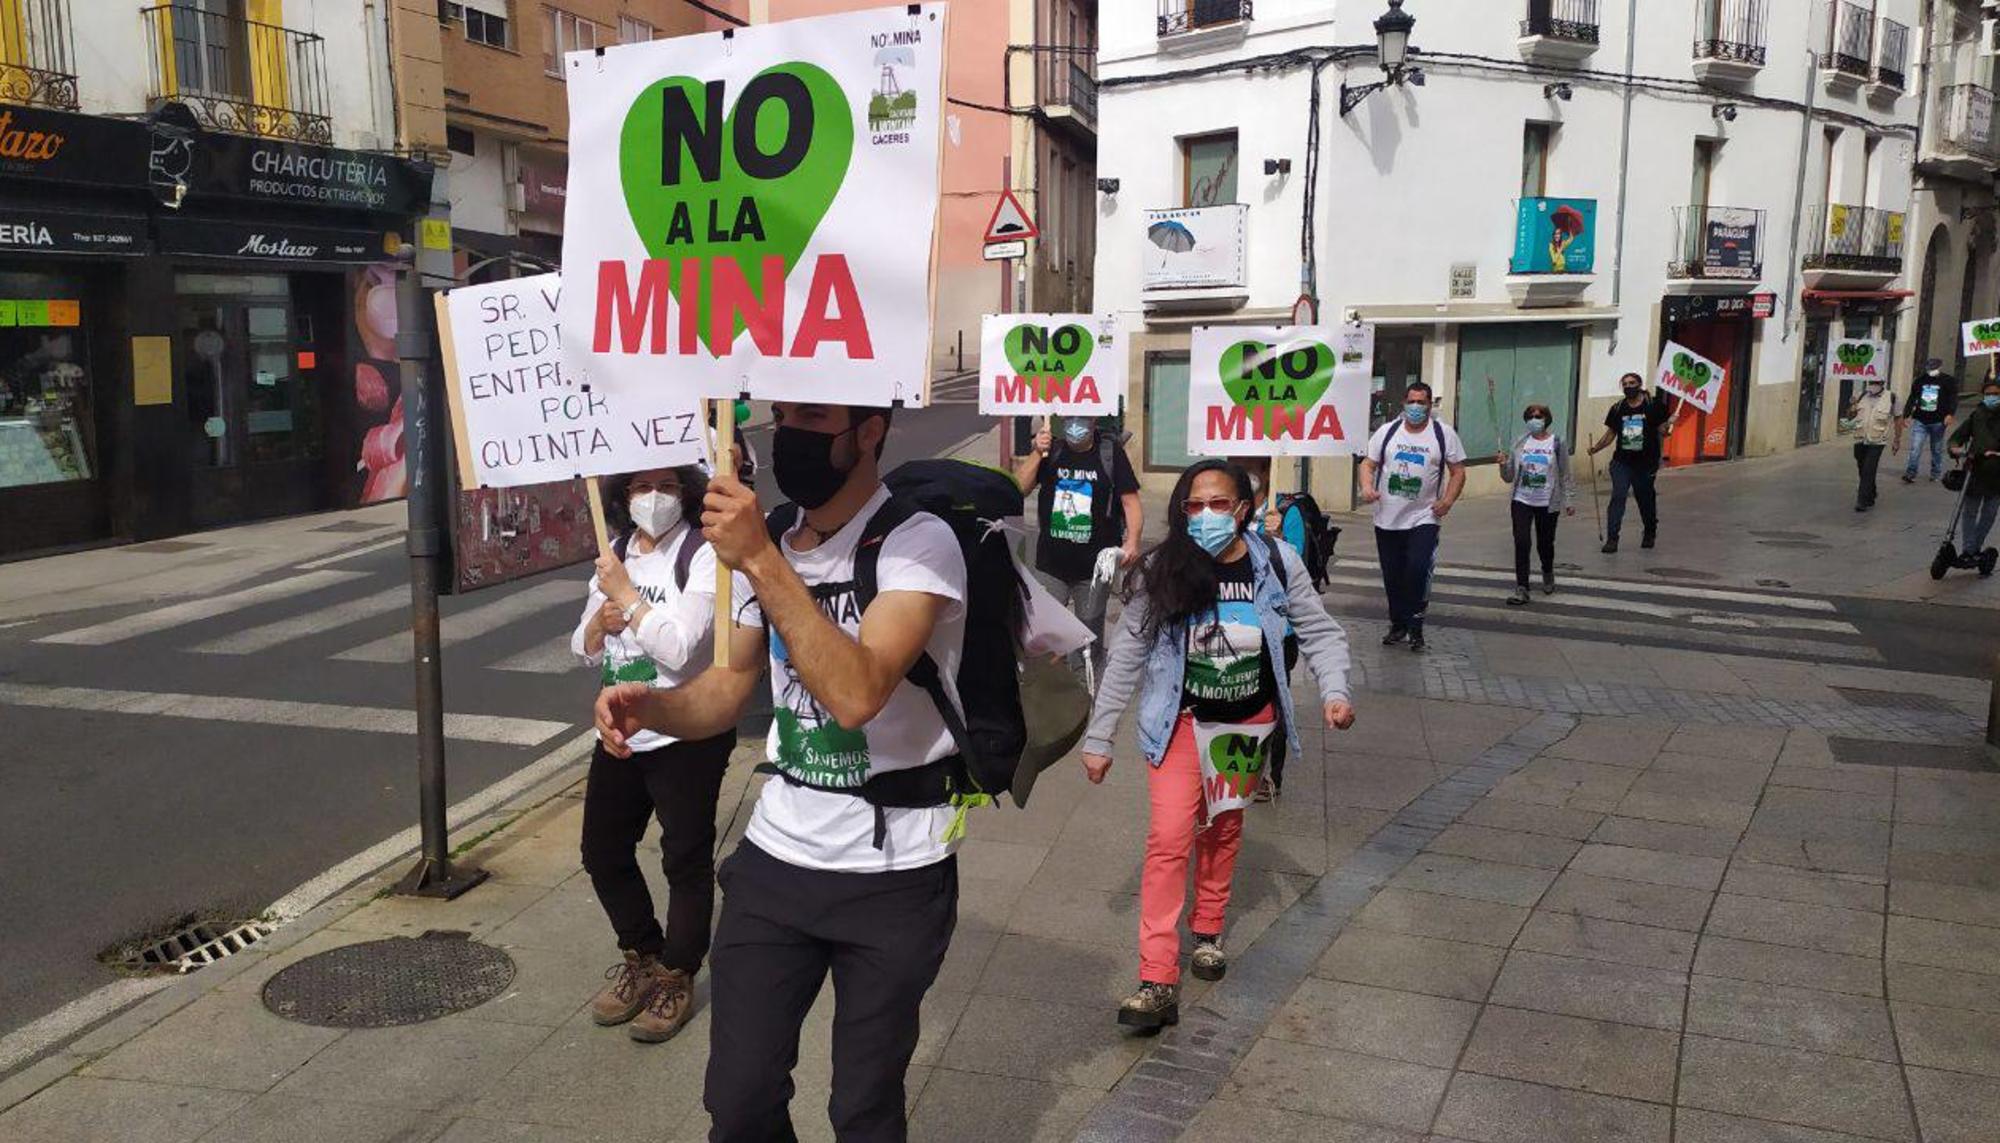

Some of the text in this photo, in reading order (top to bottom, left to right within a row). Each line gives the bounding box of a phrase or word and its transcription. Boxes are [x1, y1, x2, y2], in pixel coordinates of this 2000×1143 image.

[871, 30, 921, 48] NO MINA
[661, 71, 815, 186] NO
[251, 151, 387, 186] CHARCUTERÍA
[250, 178, 317, 198] PRODUCTOS
[665, 196, 766, 245] A LA
[0, 222, 54, 245] ERÍA
[238, 234, 318, 256] Mostazo
[480, 286, 562, 323] SR. V
[593, 253, 875, 359] MINA
[485, 323, 561, 361] PEDI
[1021, 325, 1080, 355] NO
[1844, 344, 1869, 357] NO
[1024, 360, 1065, 372] A LA
[1241, 343, 1318, 380] NO
[1681, 354, 1707, 377] NO
[470, 361, 561, 400] ENTR
[995, 375, 1101, 403] MINA
[1244, 385, 1298, 400] A LA
[1206, 404, 1345, 441] MINA
[481, 413, 700, 469] QUINTA VEZ
[1057, 468, 1098, 481] NO MINA
[635, 585, 667, 604] INA
[1219, 582, 1254, 600] MIN
[818, 591, 860, 624] NA
[1185, 680, 1200, 697] LA
[1227, 735, 1259, 759] N
[1227, 760, 1258, 773] A L
